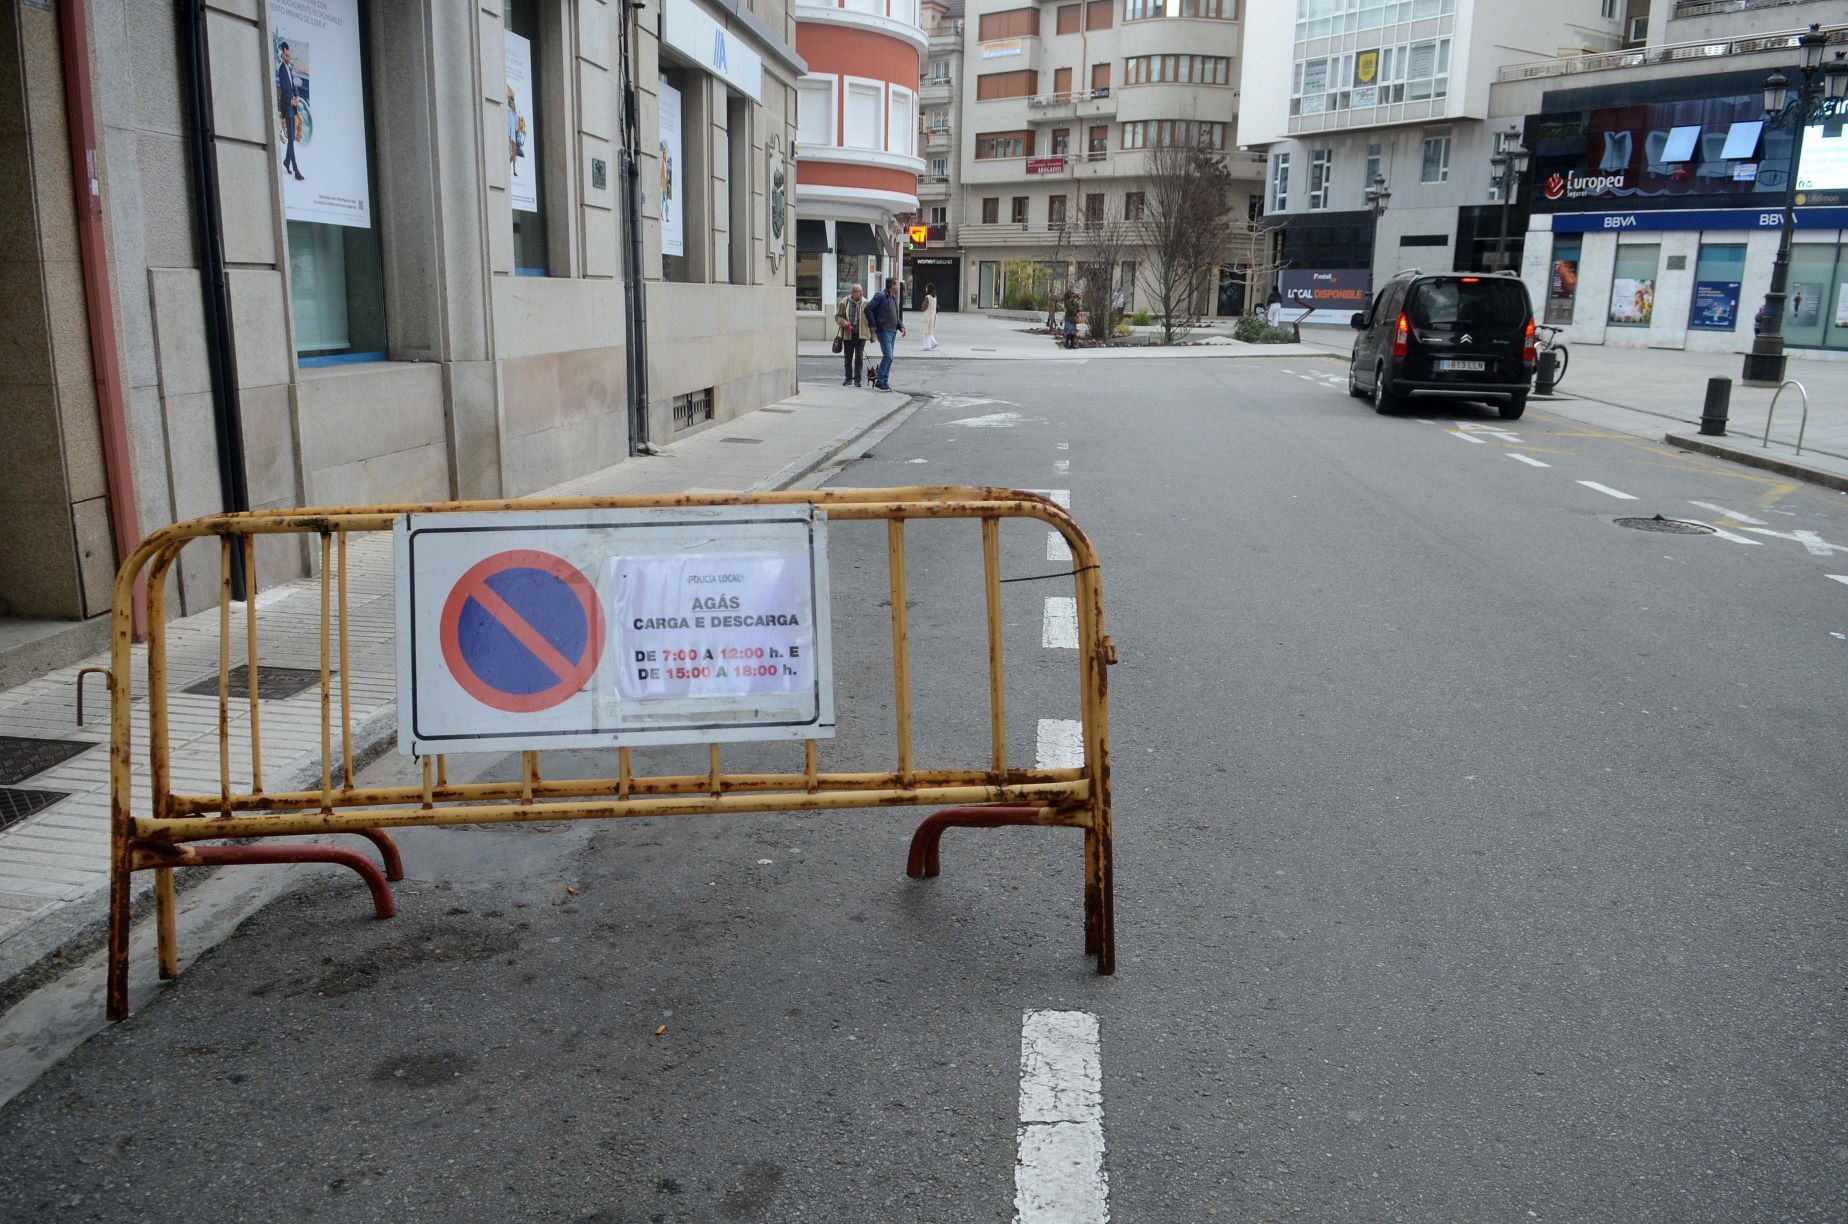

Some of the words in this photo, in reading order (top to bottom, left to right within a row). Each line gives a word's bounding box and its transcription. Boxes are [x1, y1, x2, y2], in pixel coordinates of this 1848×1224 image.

[1567, 170, 1624, 193] Europea
[1604, 216, 1637, 227] BBVA
[1314, 289, 1363, 300] DISPONIBLE
[691, 593, 741, 611] AGÁS
[633, 617, 690, 631] CARGA
[694, 616, 705, 628] E
[710, 614, 800, 629] DESCARGA
[634, 650, 657, 663] DE
[662, 649, 699, 662] 7:00
[702, 649, 715, 661] A
[719, 647, 765, 660] 12:00
[769, 646, 784, 658] h.
[789, 645, 800, 658] E
[637, 667, 661, 681] DE
[665, 666, 711, 680] 15:00
[716, 666, 728, 678] A
[733, 664, 778, 678] 18:00
[783, 664, 798, 676] h.
